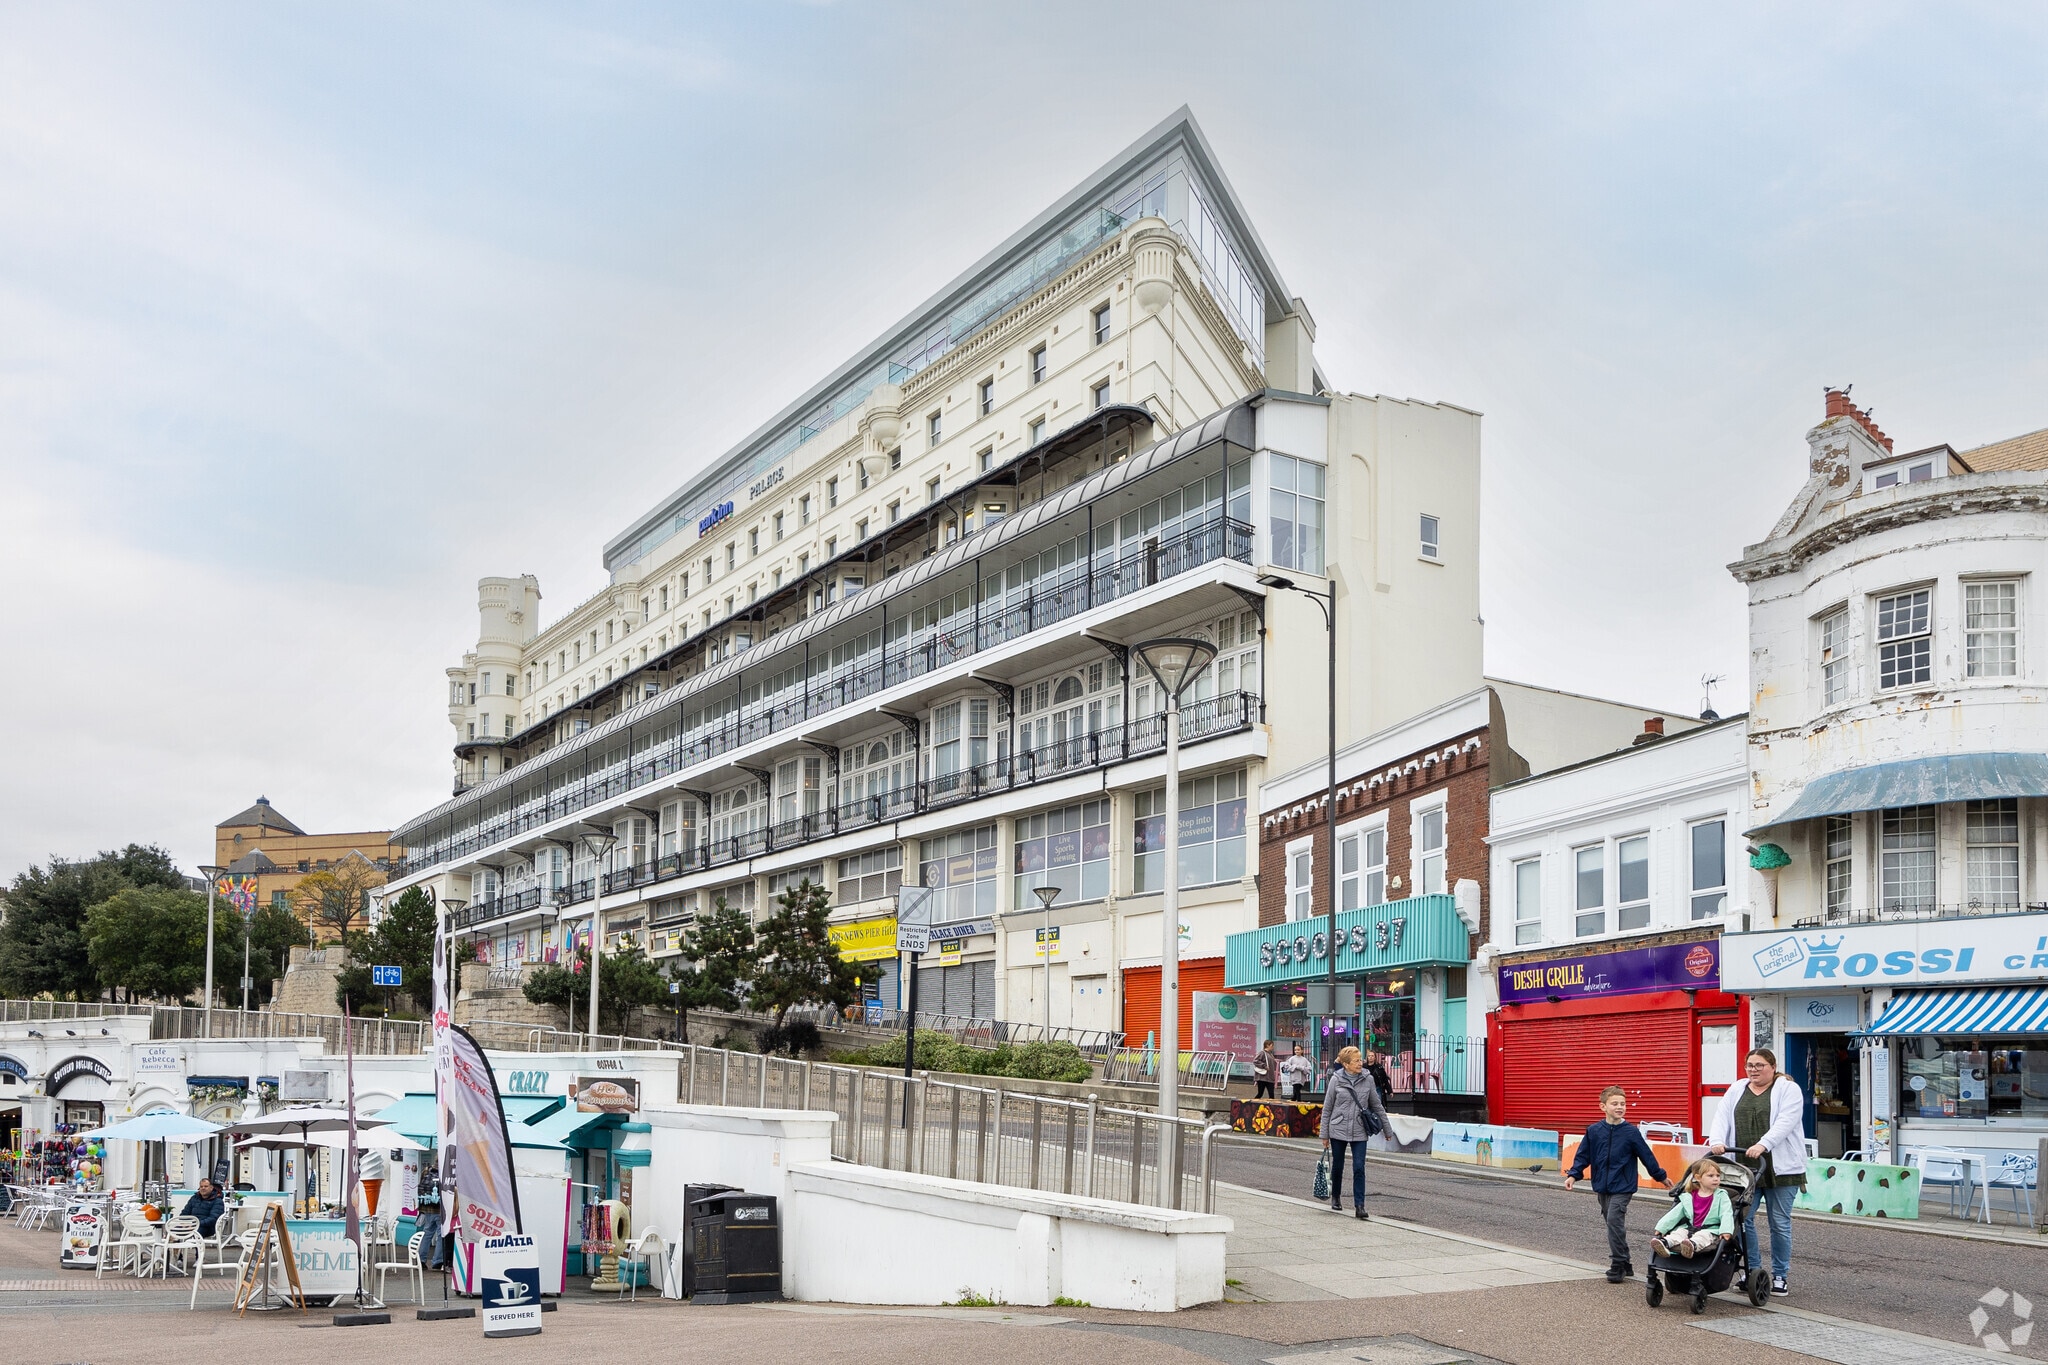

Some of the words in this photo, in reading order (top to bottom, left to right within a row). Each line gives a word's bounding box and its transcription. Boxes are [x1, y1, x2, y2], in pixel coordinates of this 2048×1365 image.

[750, 466, 784, 500] PALACE
[1178, 819, 1195, 829] Step
[1196, 814, 1212, 824] into
[1059, 835, 1071, 844] Live
[1054, 844, 1075, 854] Sports
[1053, 853, 1076, 863] viewing
[844, 929, 864, 941] NEWS
[866, 927, 881, 938] PIER
[900, 926, 928, 934] Restricted
[954, 924, 977, 937] DINER
[900, 940, 925, 949] ENDS
[943, 944, 958, 952] GRAY
[1260, 924, 1367, 968] SCOOPS
[1375, 917, 1407, 950] 37
[1768, 945, 1784, 957] the
[1689, 957, 1709, 965] Original
[1763, 948, 1798, 972] original
[1803, 947, 1975, 979] ROSSI
[1503, 968, 1513, 979] the
[1513, 968, 1544, 991] DESHI
[1546, 963, 1584, 989] GRILLE
[1583, 973, 1612, 993] adventure
[1806, 1000, 1836, 1017] Rossi
[141, 1056, 175, 1064] Rebecca
[453, 1055, 473, 1074] CE
[508, 1070, 549, 1093] CRAZY
[596, 1085, 617, 1094] HOT
[466, 1203, 505, 1229] SOLD
[471, 1219, 502, 1236] HER
[484, 1235, 534, 1248] LAVAZZA
[490, 1313, 516, 1321] SERVED
